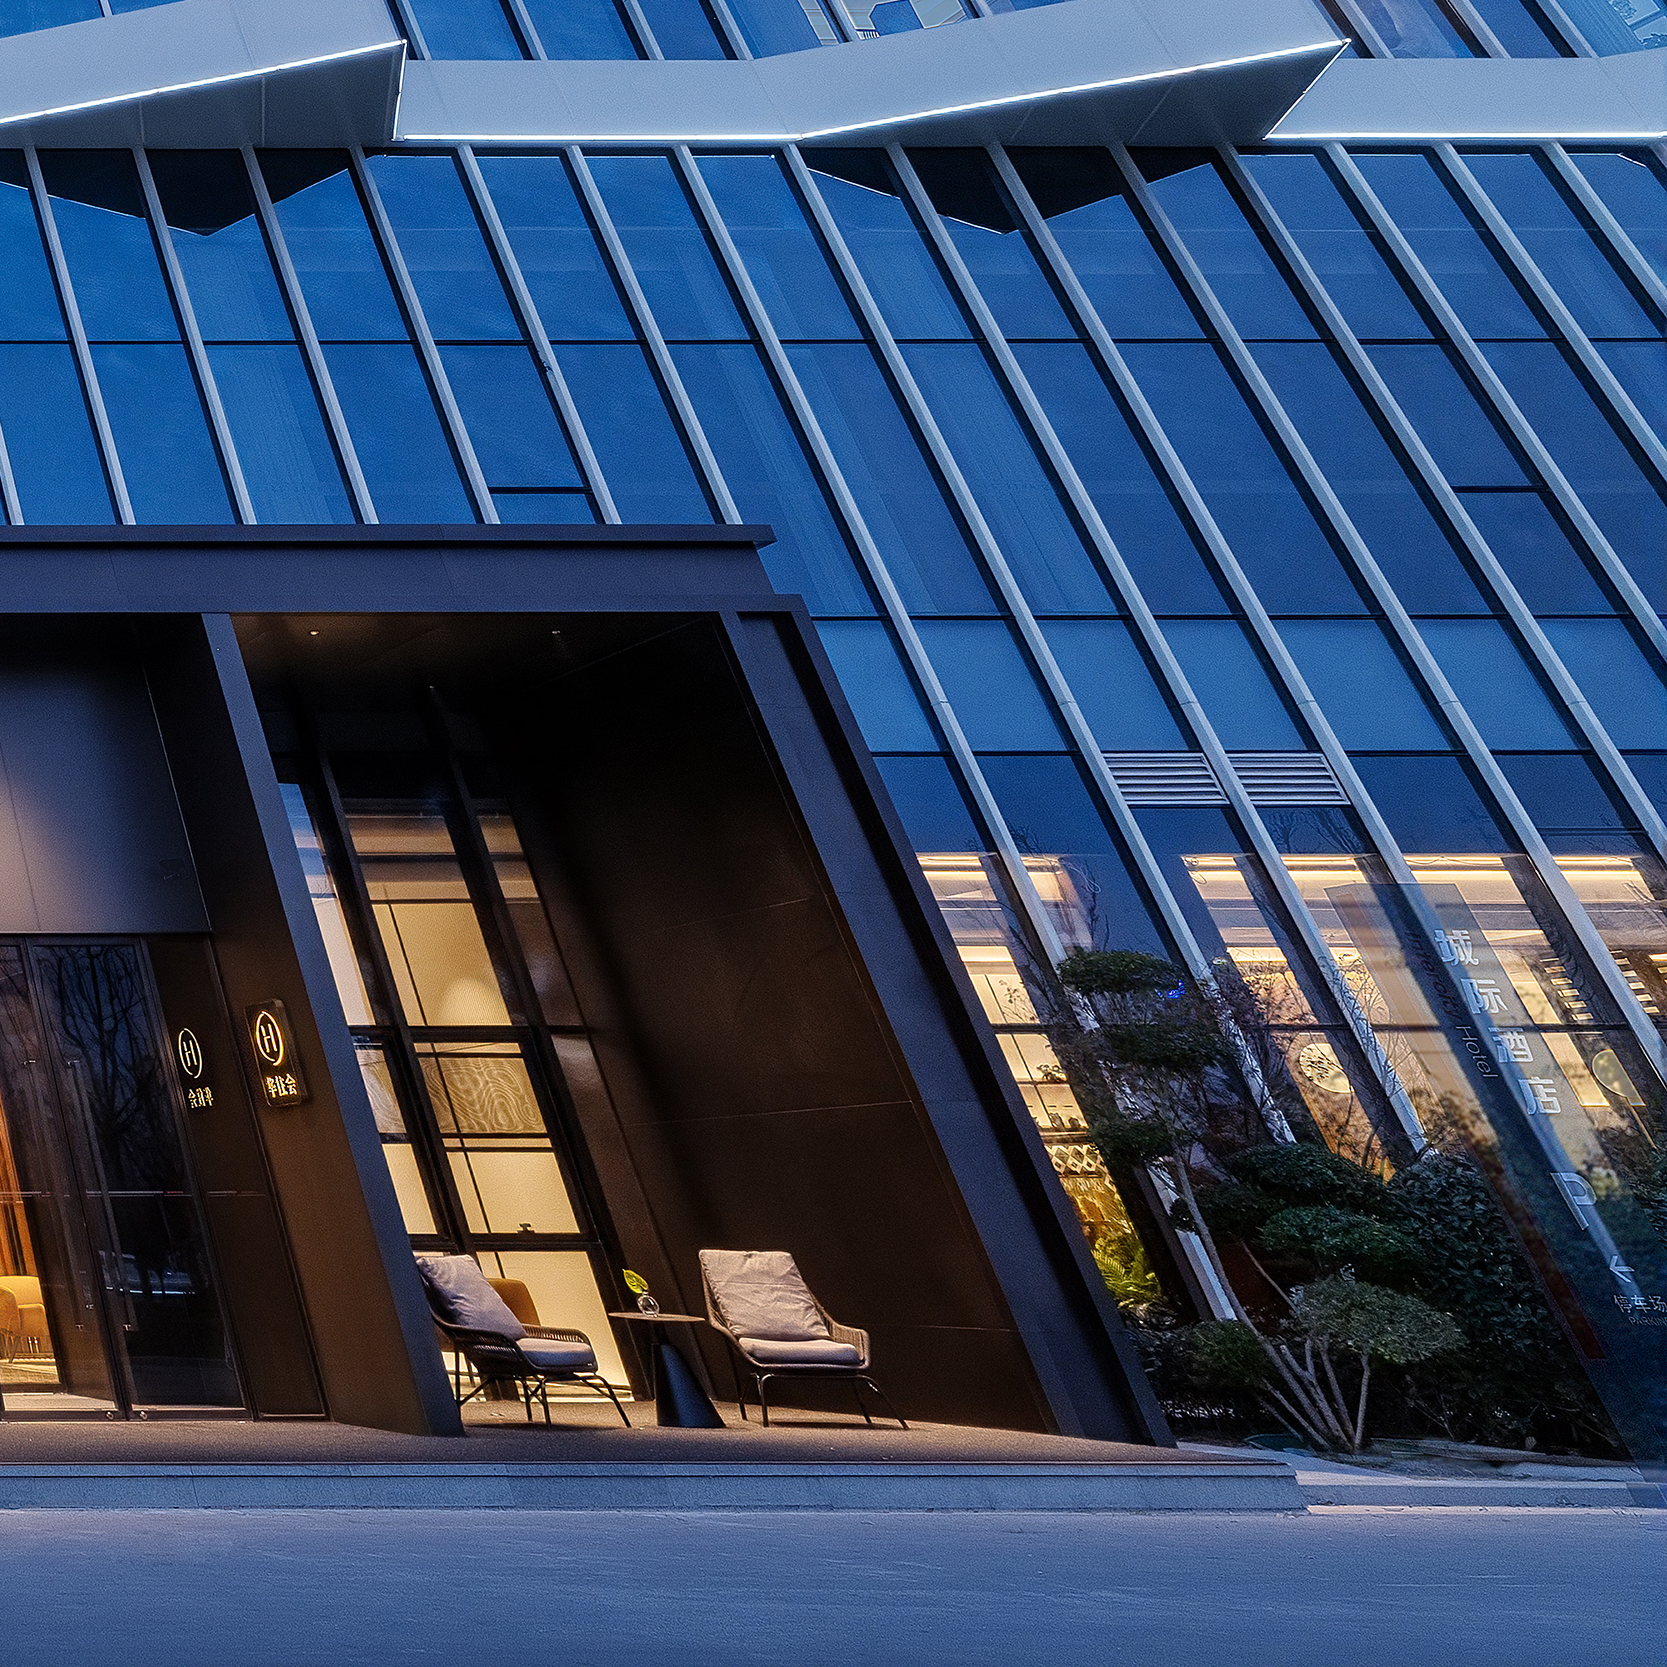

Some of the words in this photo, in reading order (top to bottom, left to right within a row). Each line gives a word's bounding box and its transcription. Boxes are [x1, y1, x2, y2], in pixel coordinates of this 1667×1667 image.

[1433, 928, 1562, 1115] 城际酒店
[1550, 1172, 1598, 1231] P
[1613, 1295, 1667, 1313] 停车场
